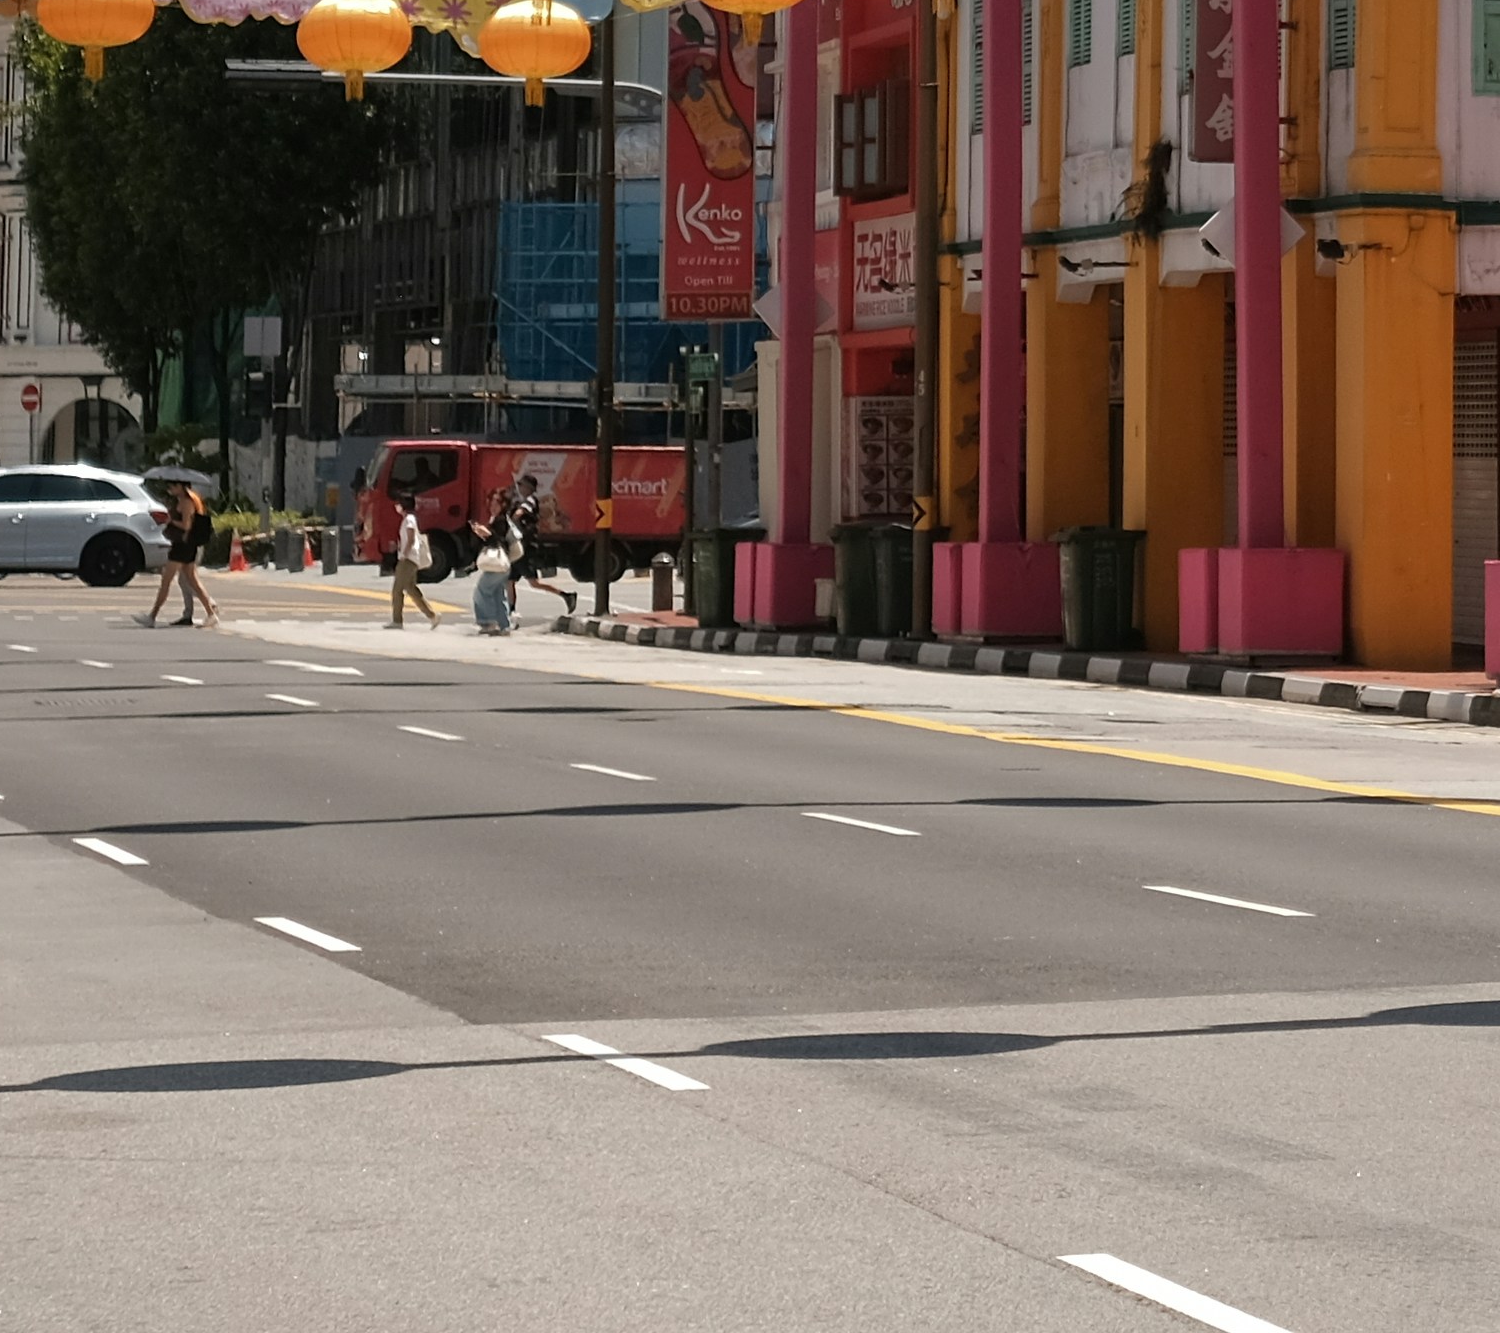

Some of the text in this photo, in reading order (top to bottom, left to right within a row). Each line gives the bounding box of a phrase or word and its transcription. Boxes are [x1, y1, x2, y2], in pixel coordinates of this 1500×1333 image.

[676, 182, 743, 245] Kenko
[684, 275, 733, 287] Open Till
[669, 296, 749, 314] 10.30PM
[917, 369, 926, 397] 45
